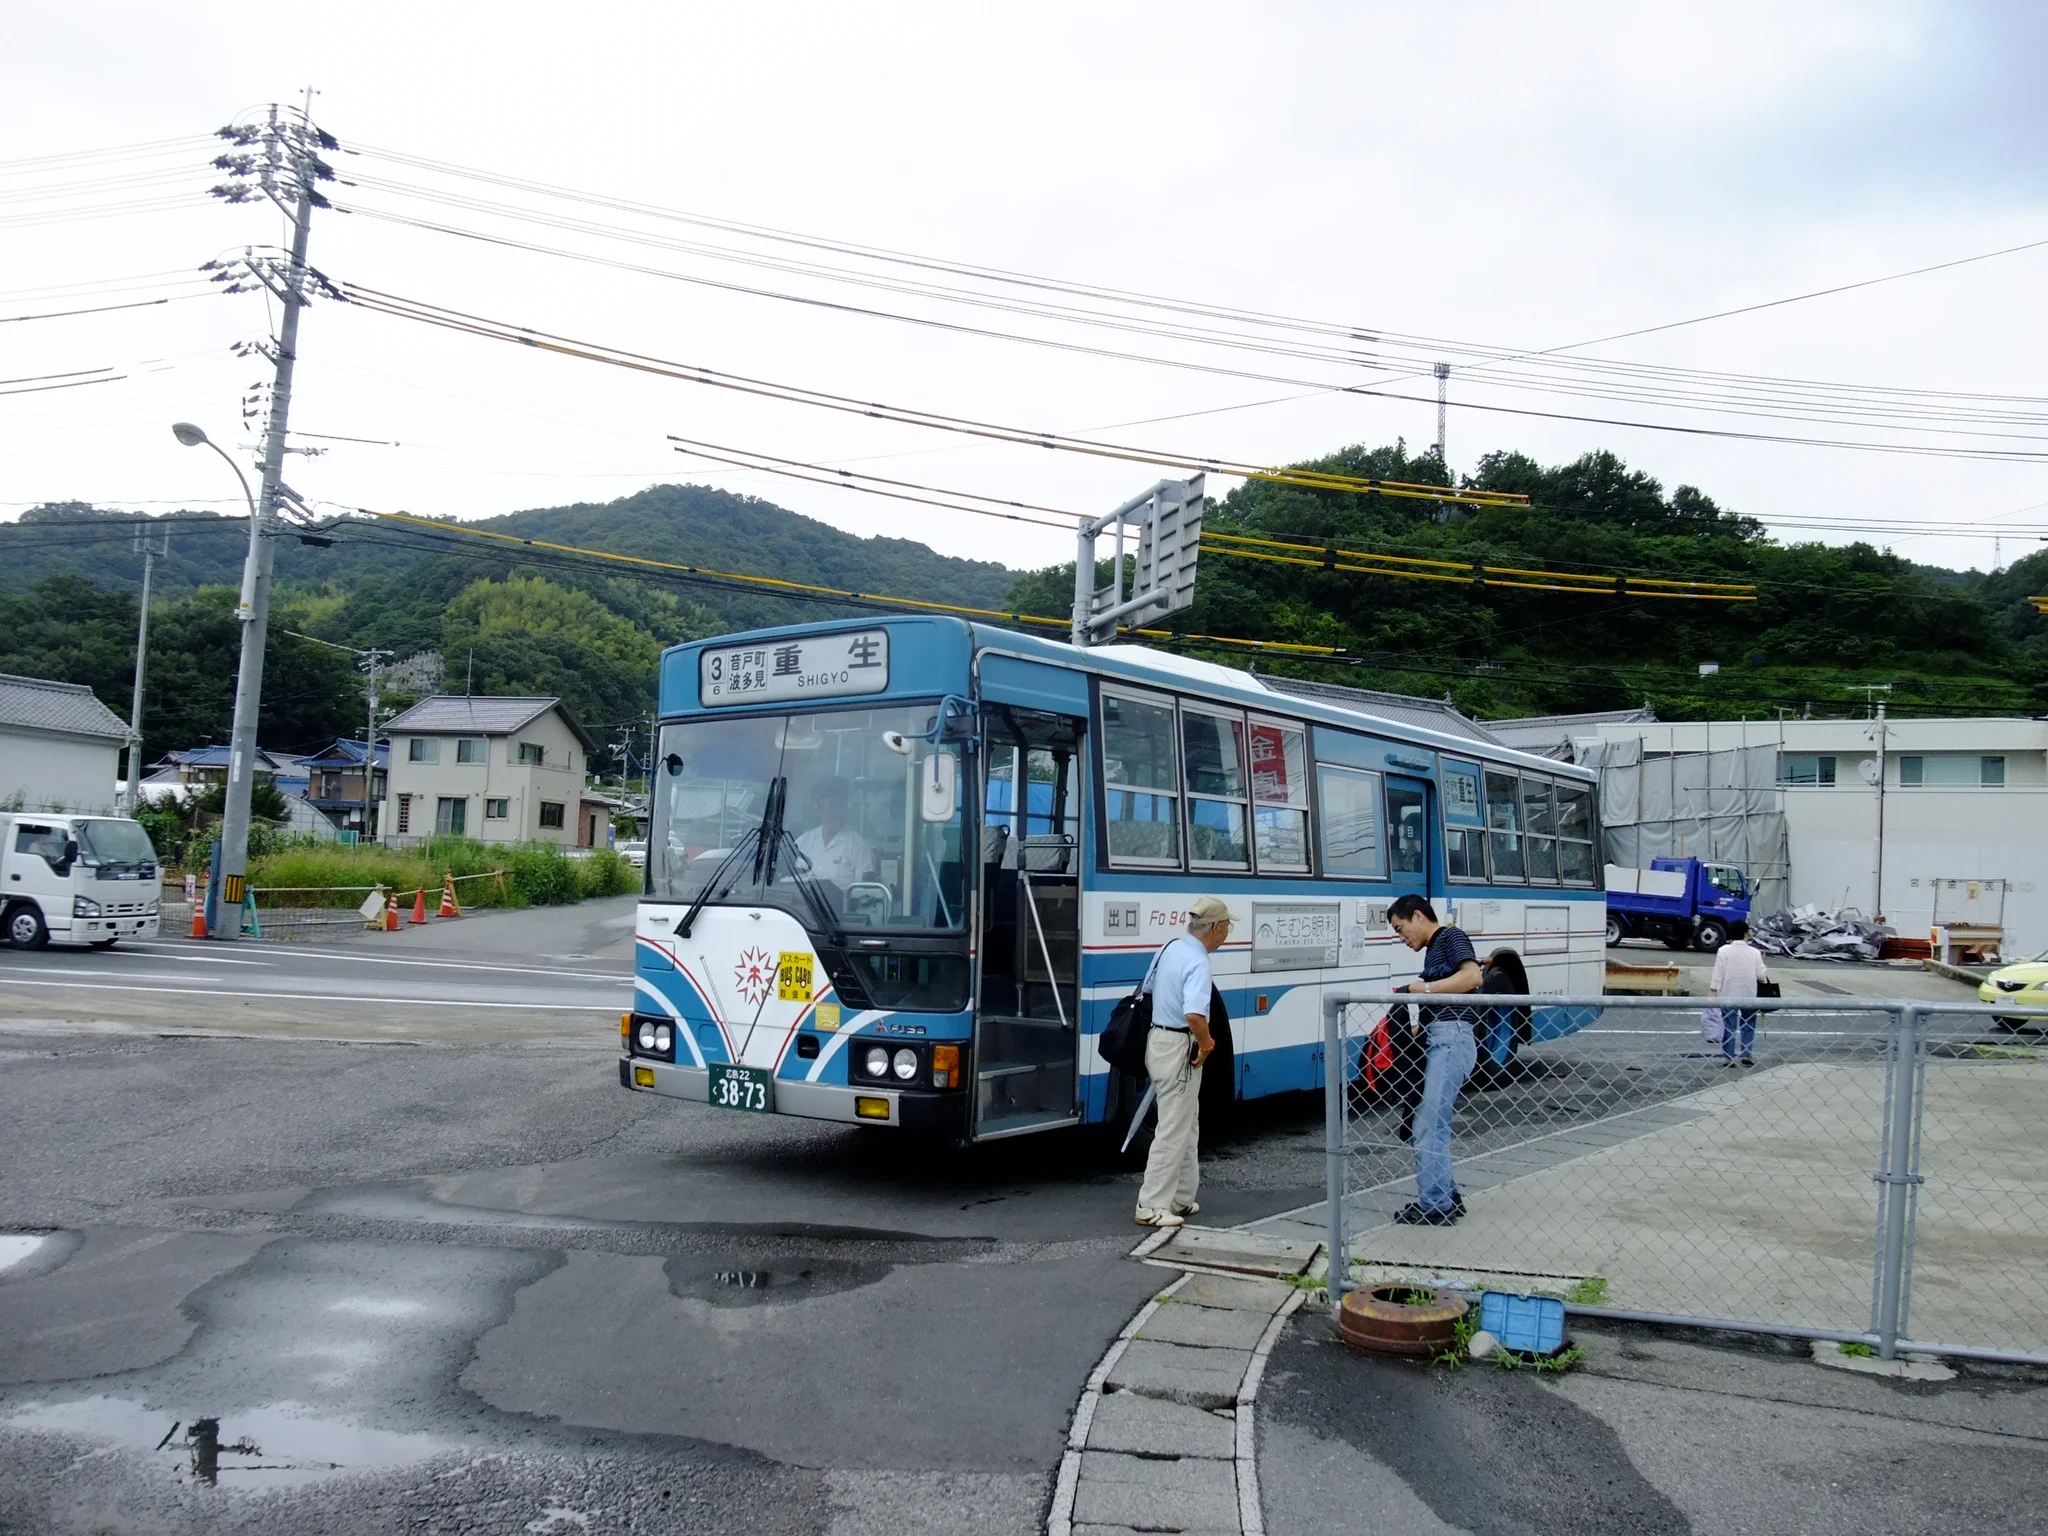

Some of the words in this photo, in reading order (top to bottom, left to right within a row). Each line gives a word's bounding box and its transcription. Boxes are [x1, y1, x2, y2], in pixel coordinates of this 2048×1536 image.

[711, 656, 722, 681] 3
[730, 651, 766, 671] 音戸町
[729, 670, 766, 691] 波多見
[798, 671, 849, 687] SHIGYO
[713, 686, 720, 695] 6
[1108, 909, 1137, 928] 出口
[1275, 915, 1337, 938] たむら眼科
[1369, 909, 1387, 925] 入口
[780, 954, 813, 965] バスカード
[780, 966, 793, 983] BUS
[795, 966, 811, 985] CARD
